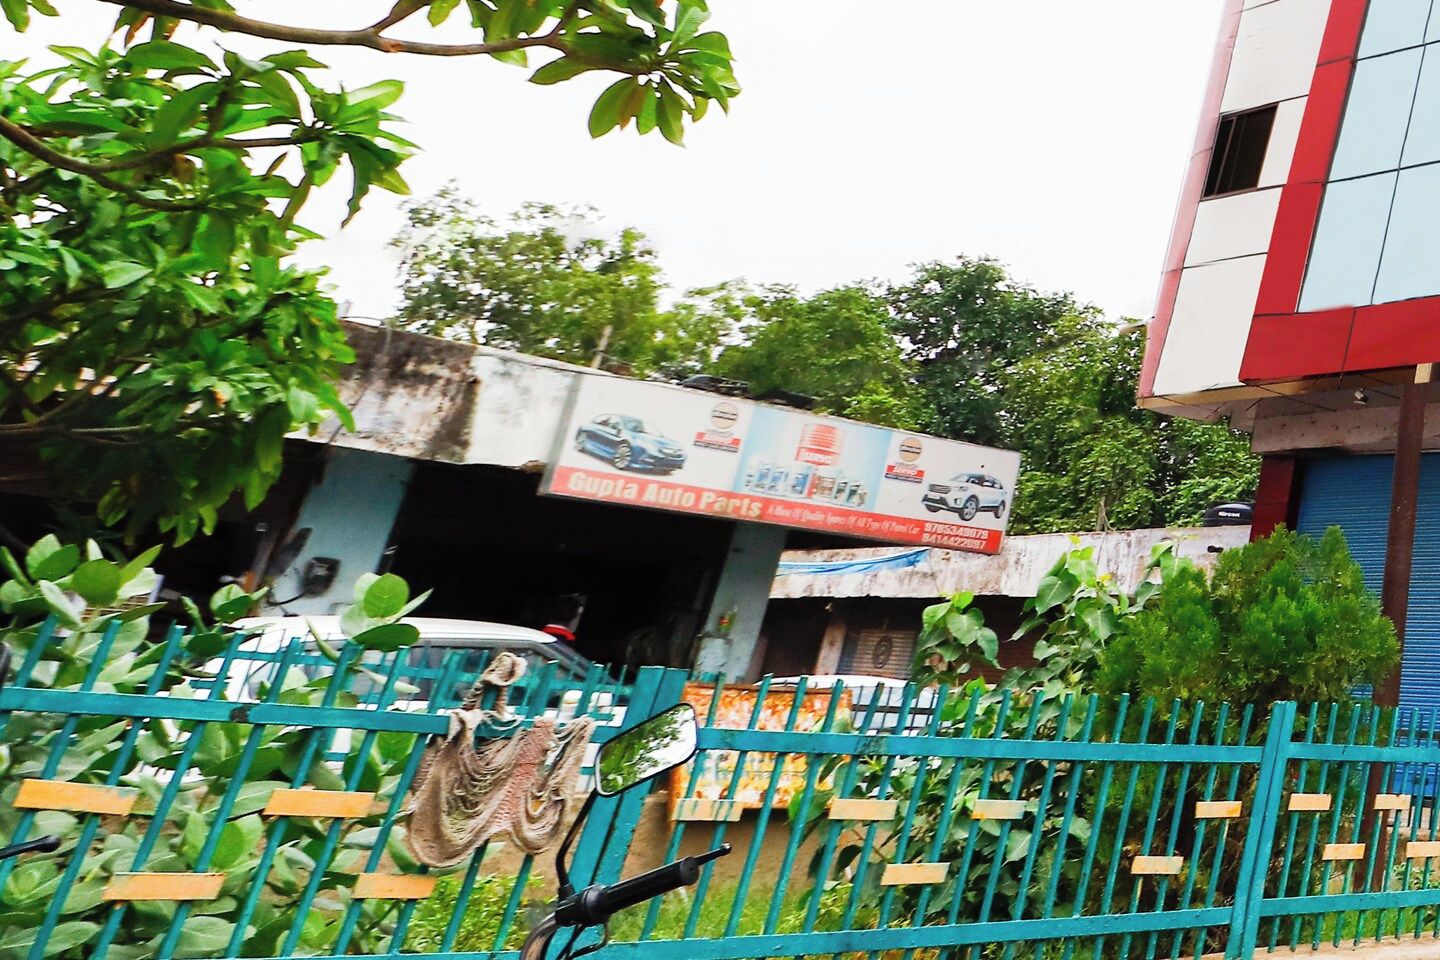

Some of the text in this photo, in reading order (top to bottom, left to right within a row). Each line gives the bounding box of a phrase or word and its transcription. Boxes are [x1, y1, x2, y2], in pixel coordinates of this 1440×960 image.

[568, 471, 763, 518] Gupta Auto Parts
